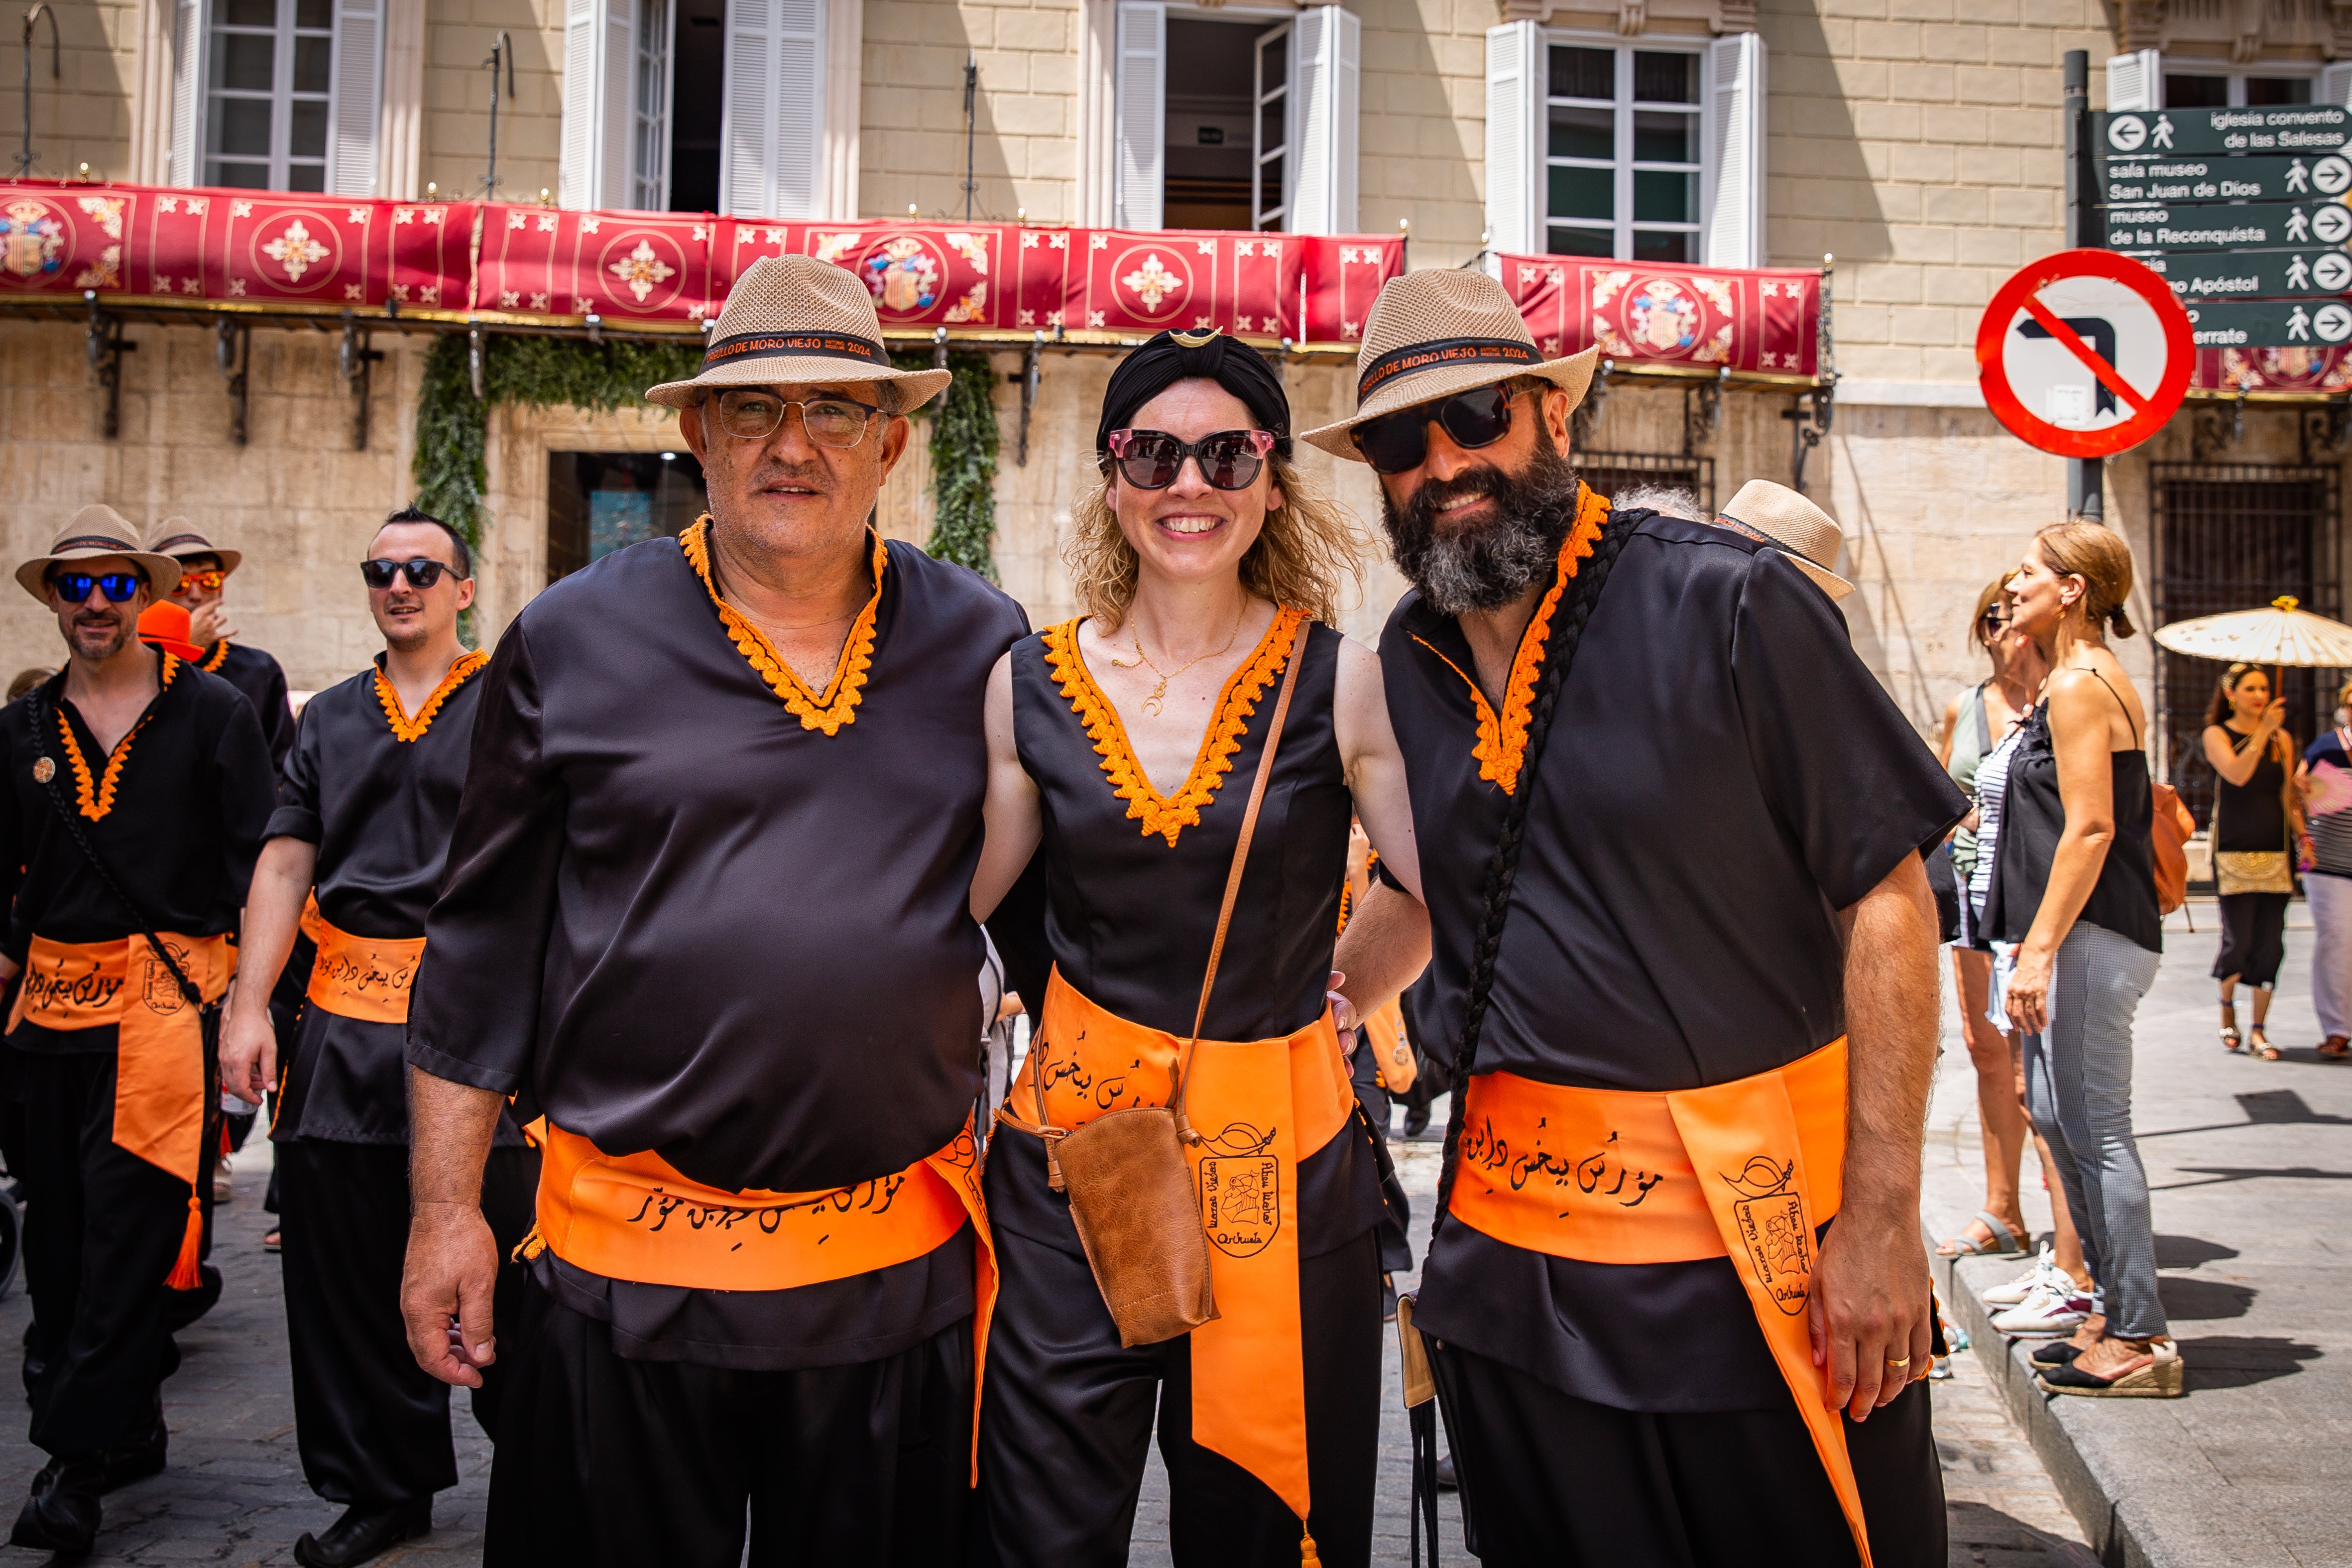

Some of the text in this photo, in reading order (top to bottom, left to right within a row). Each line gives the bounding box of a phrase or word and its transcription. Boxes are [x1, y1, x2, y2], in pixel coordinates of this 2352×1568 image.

[2210, 110, 2345, 130] iglesia convento
[2224, 130, 2345, 148] de las Salesas
[2109, 161, 2208, 179] sala museo
[2109, 180, 2262, 199] San Juan de Dios
[2110, 210, 2169, 224] museo
[2110, 227, 2266, 245] de la Reconquista
[2190, 275, 2259, 296] Apóstol
[2192, 328, 2248, 345] errate
[735, 342, 748, 353] DE
[750, 339, 785, 351] MORO
[786, 338, 821, 349] VIEJO
[847, 342, 871, 358] 2024
[1386, 361, 1401, 375] DE
[1402, 352, 1439, 369] MORO
[1441, 347, 1477, 360] VIEJO
[1503, 347, 1529, 360] 2024
